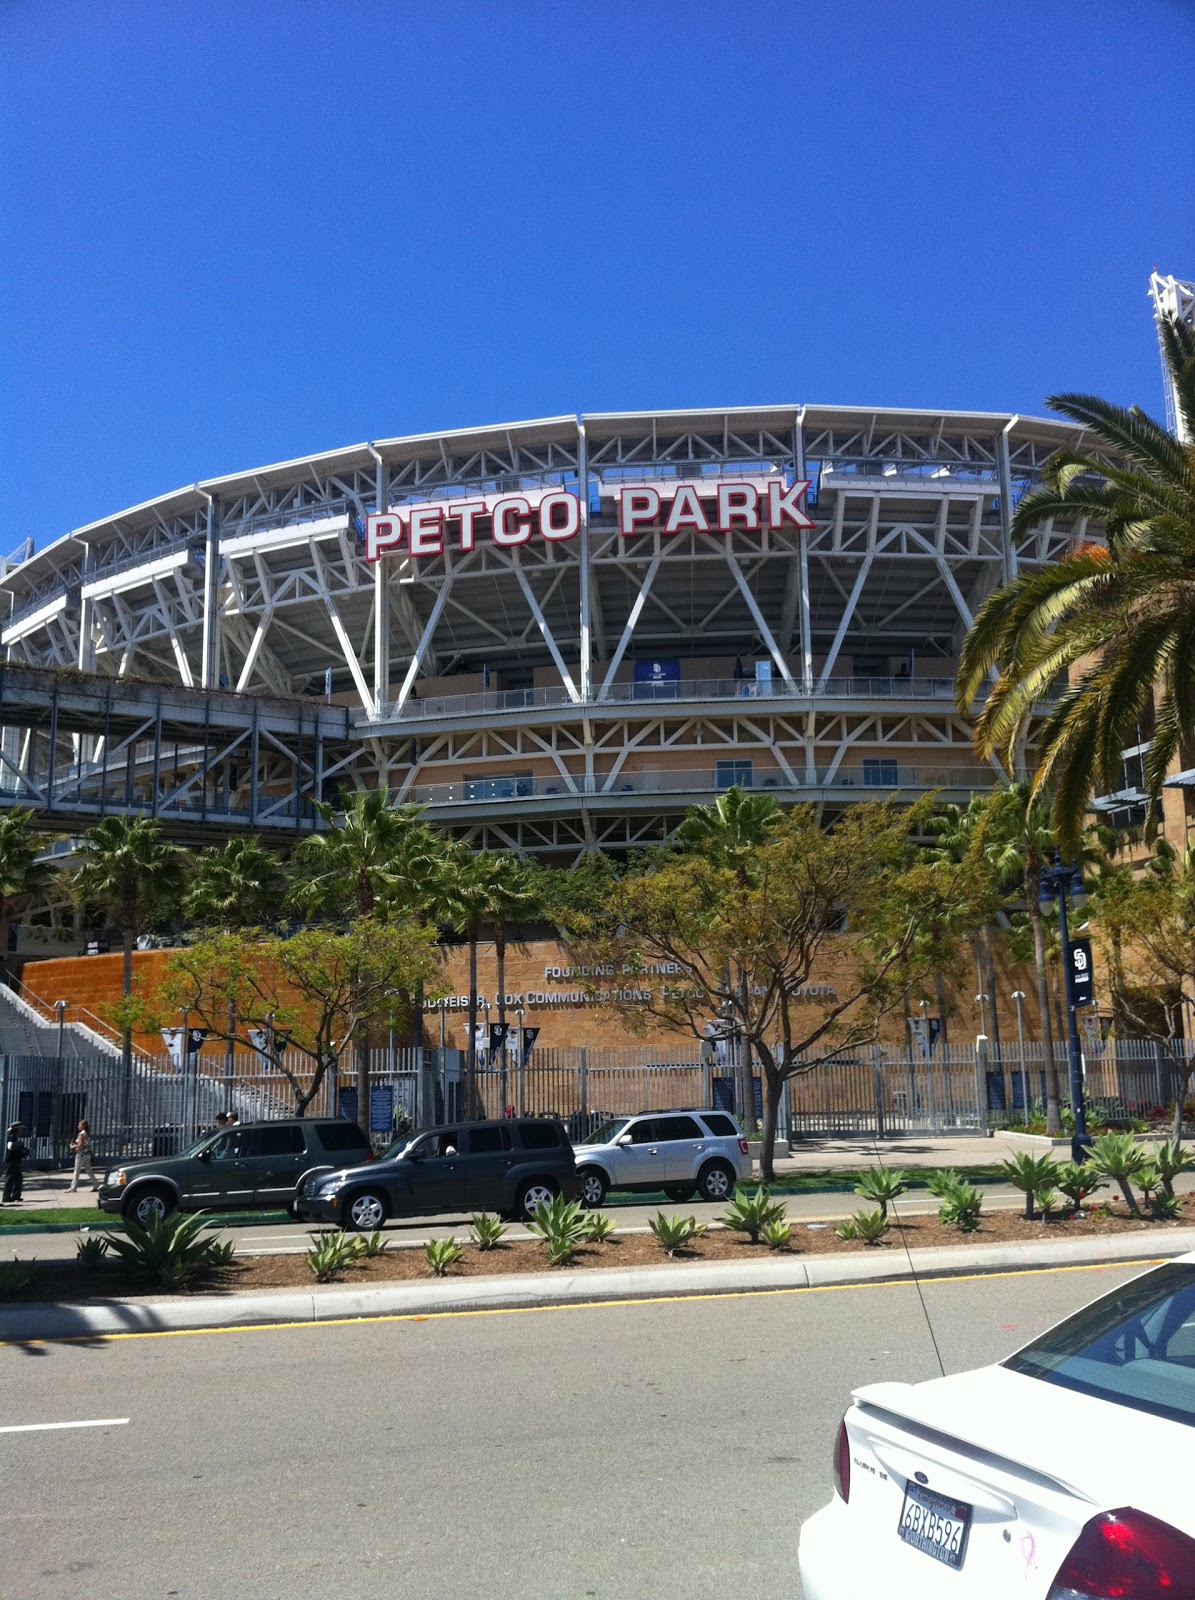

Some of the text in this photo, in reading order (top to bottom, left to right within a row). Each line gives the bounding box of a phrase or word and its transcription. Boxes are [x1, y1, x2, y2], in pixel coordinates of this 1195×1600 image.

[365, 480, 815, 562] PETCO PARK
[544, 963, 615, 978] FOUNDING
[785, 984, 835, 996] OYOTA
[905, 1503, 961, 1552] 6BXB596
